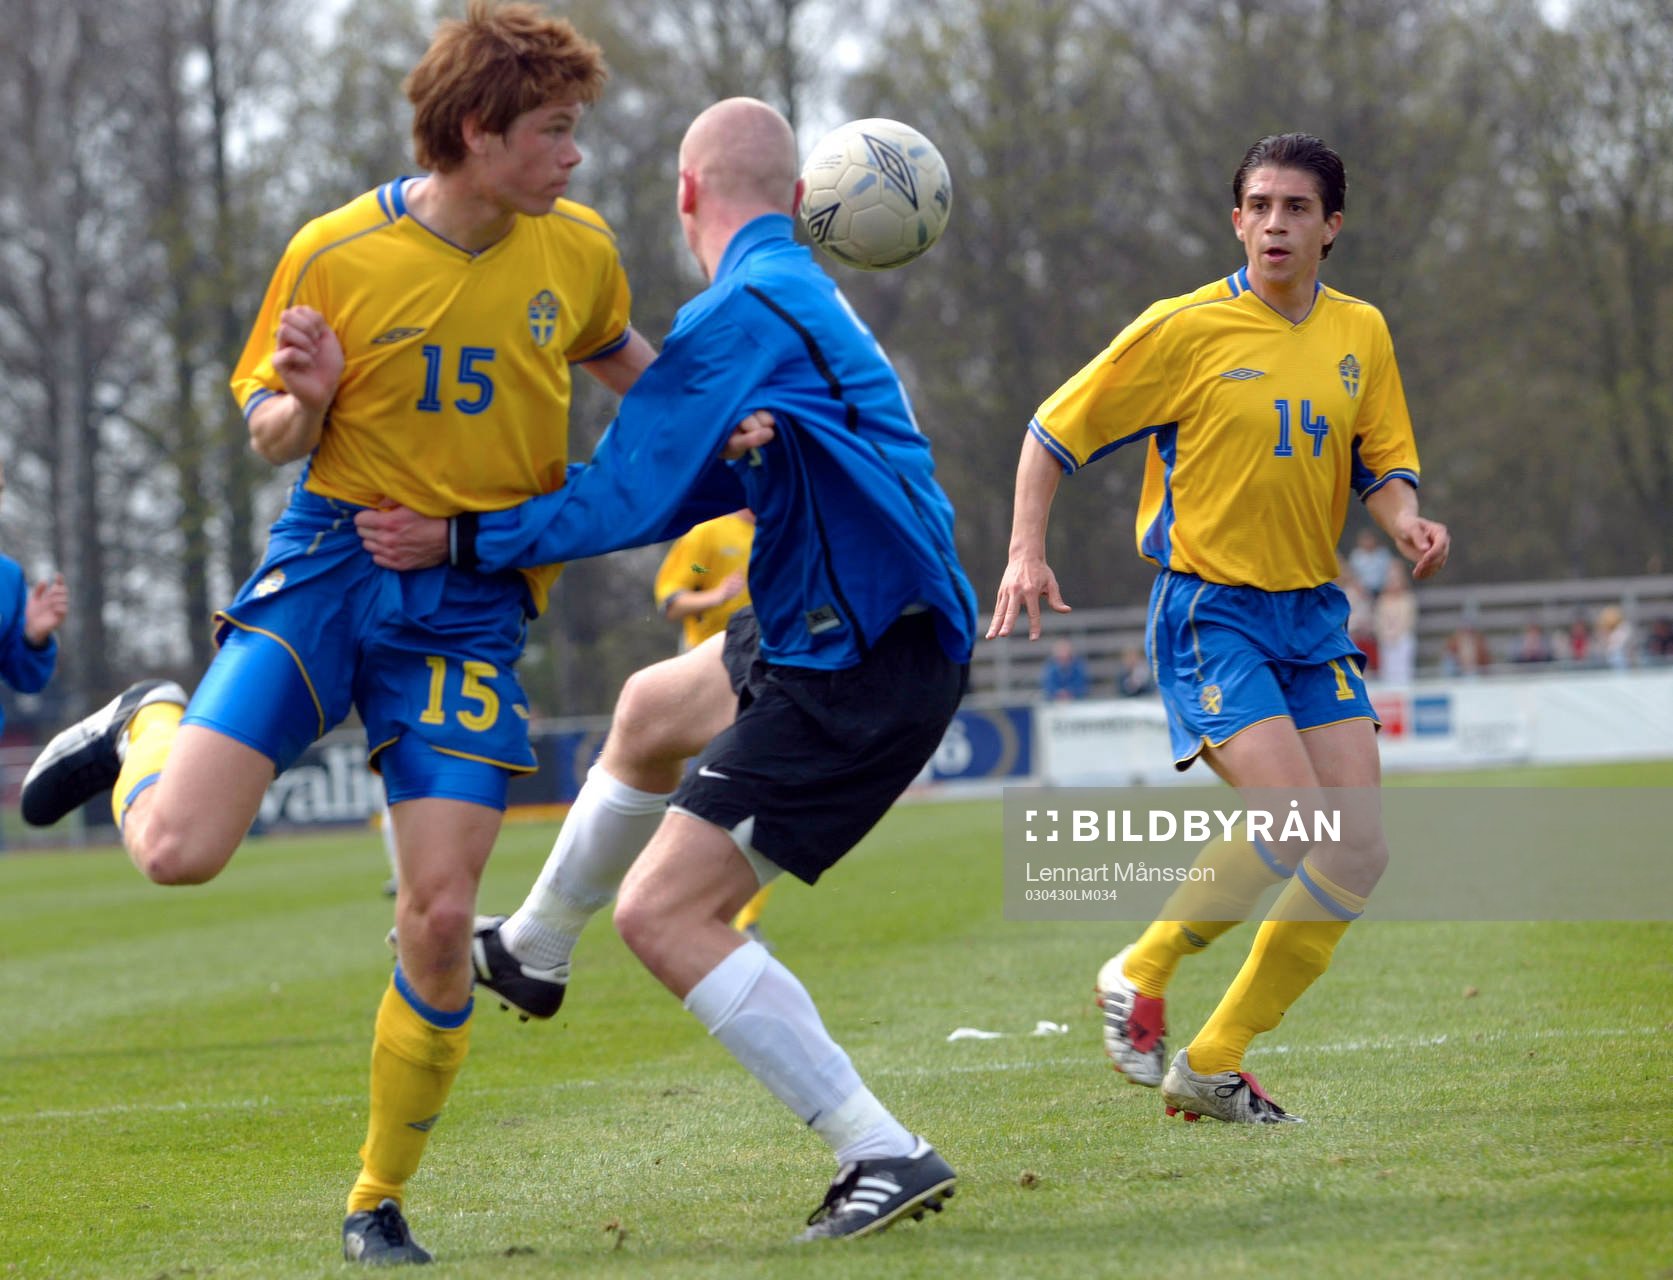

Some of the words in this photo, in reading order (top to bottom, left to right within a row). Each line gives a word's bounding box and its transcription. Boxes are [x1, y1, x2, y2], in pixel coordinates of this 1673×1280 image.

[417, 345, 496, 415] 15
[1273, 399, 1329, 457] 14
[419, 655, 500, 732] 15
